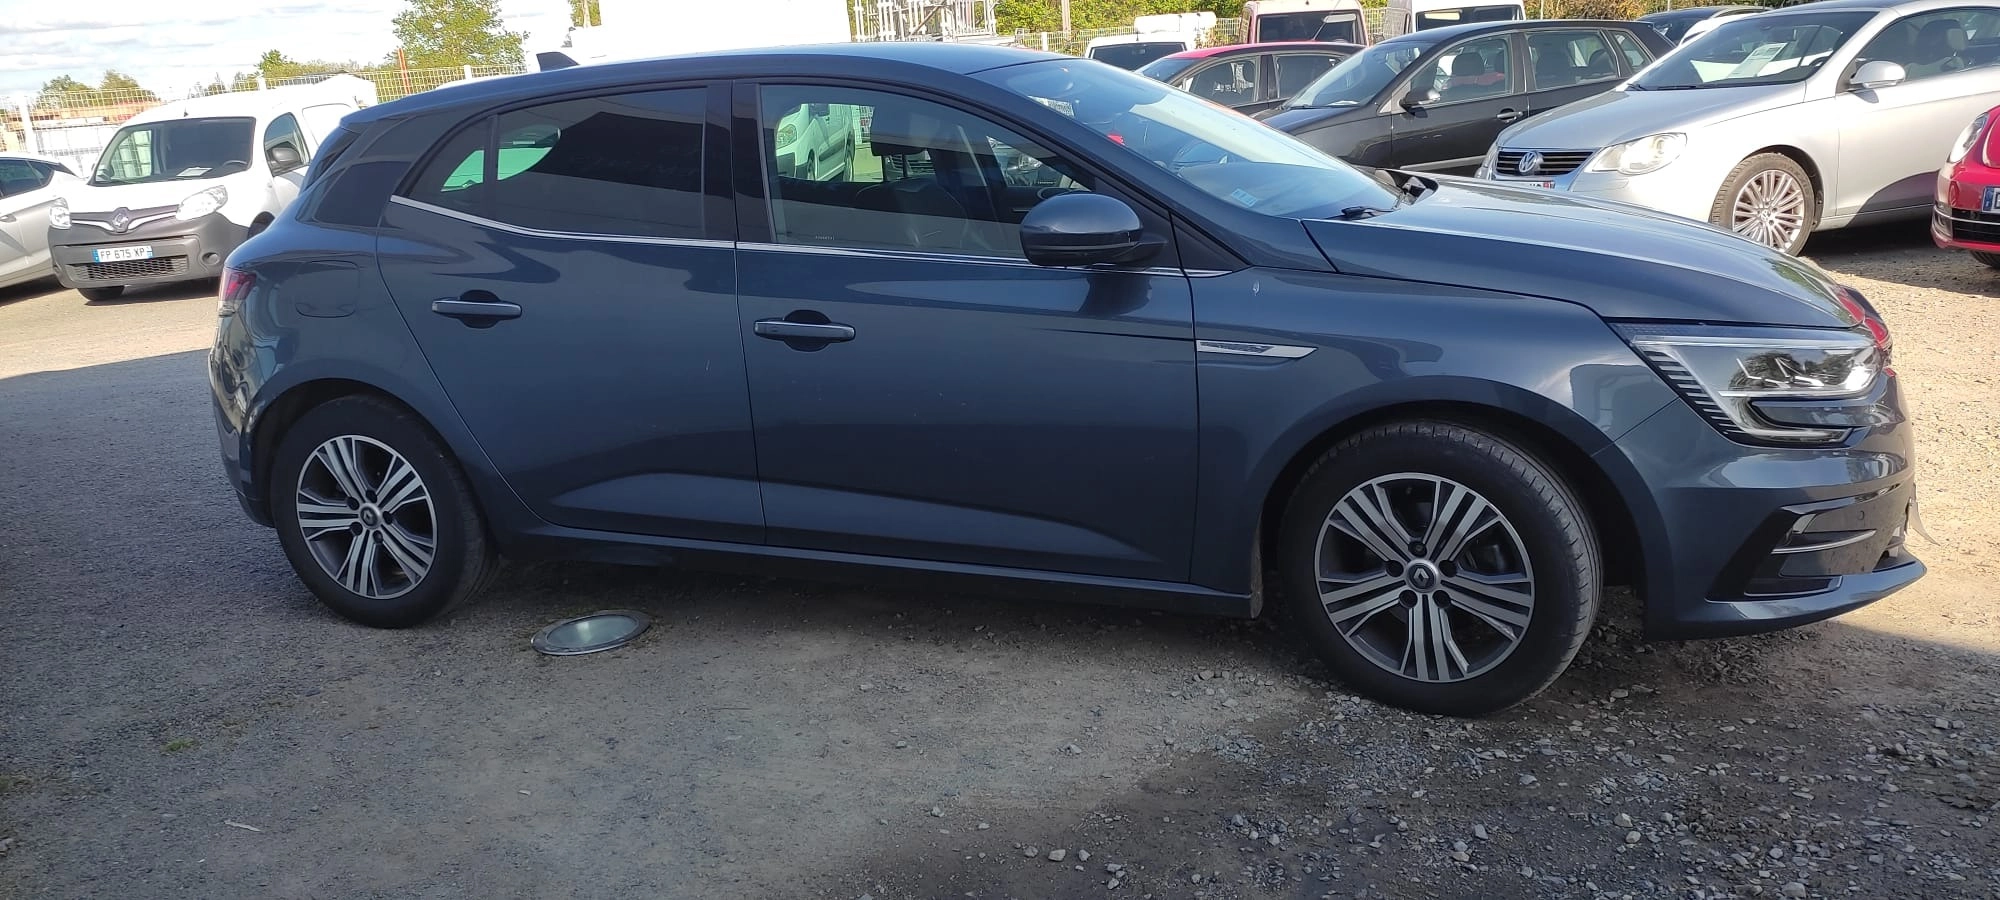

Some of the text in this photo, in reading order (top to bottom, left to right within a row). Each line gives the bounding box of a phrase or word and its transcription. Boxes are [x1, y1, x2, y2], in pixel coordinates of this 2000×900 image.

[100, 247, 145, 260] FP 675 XP
